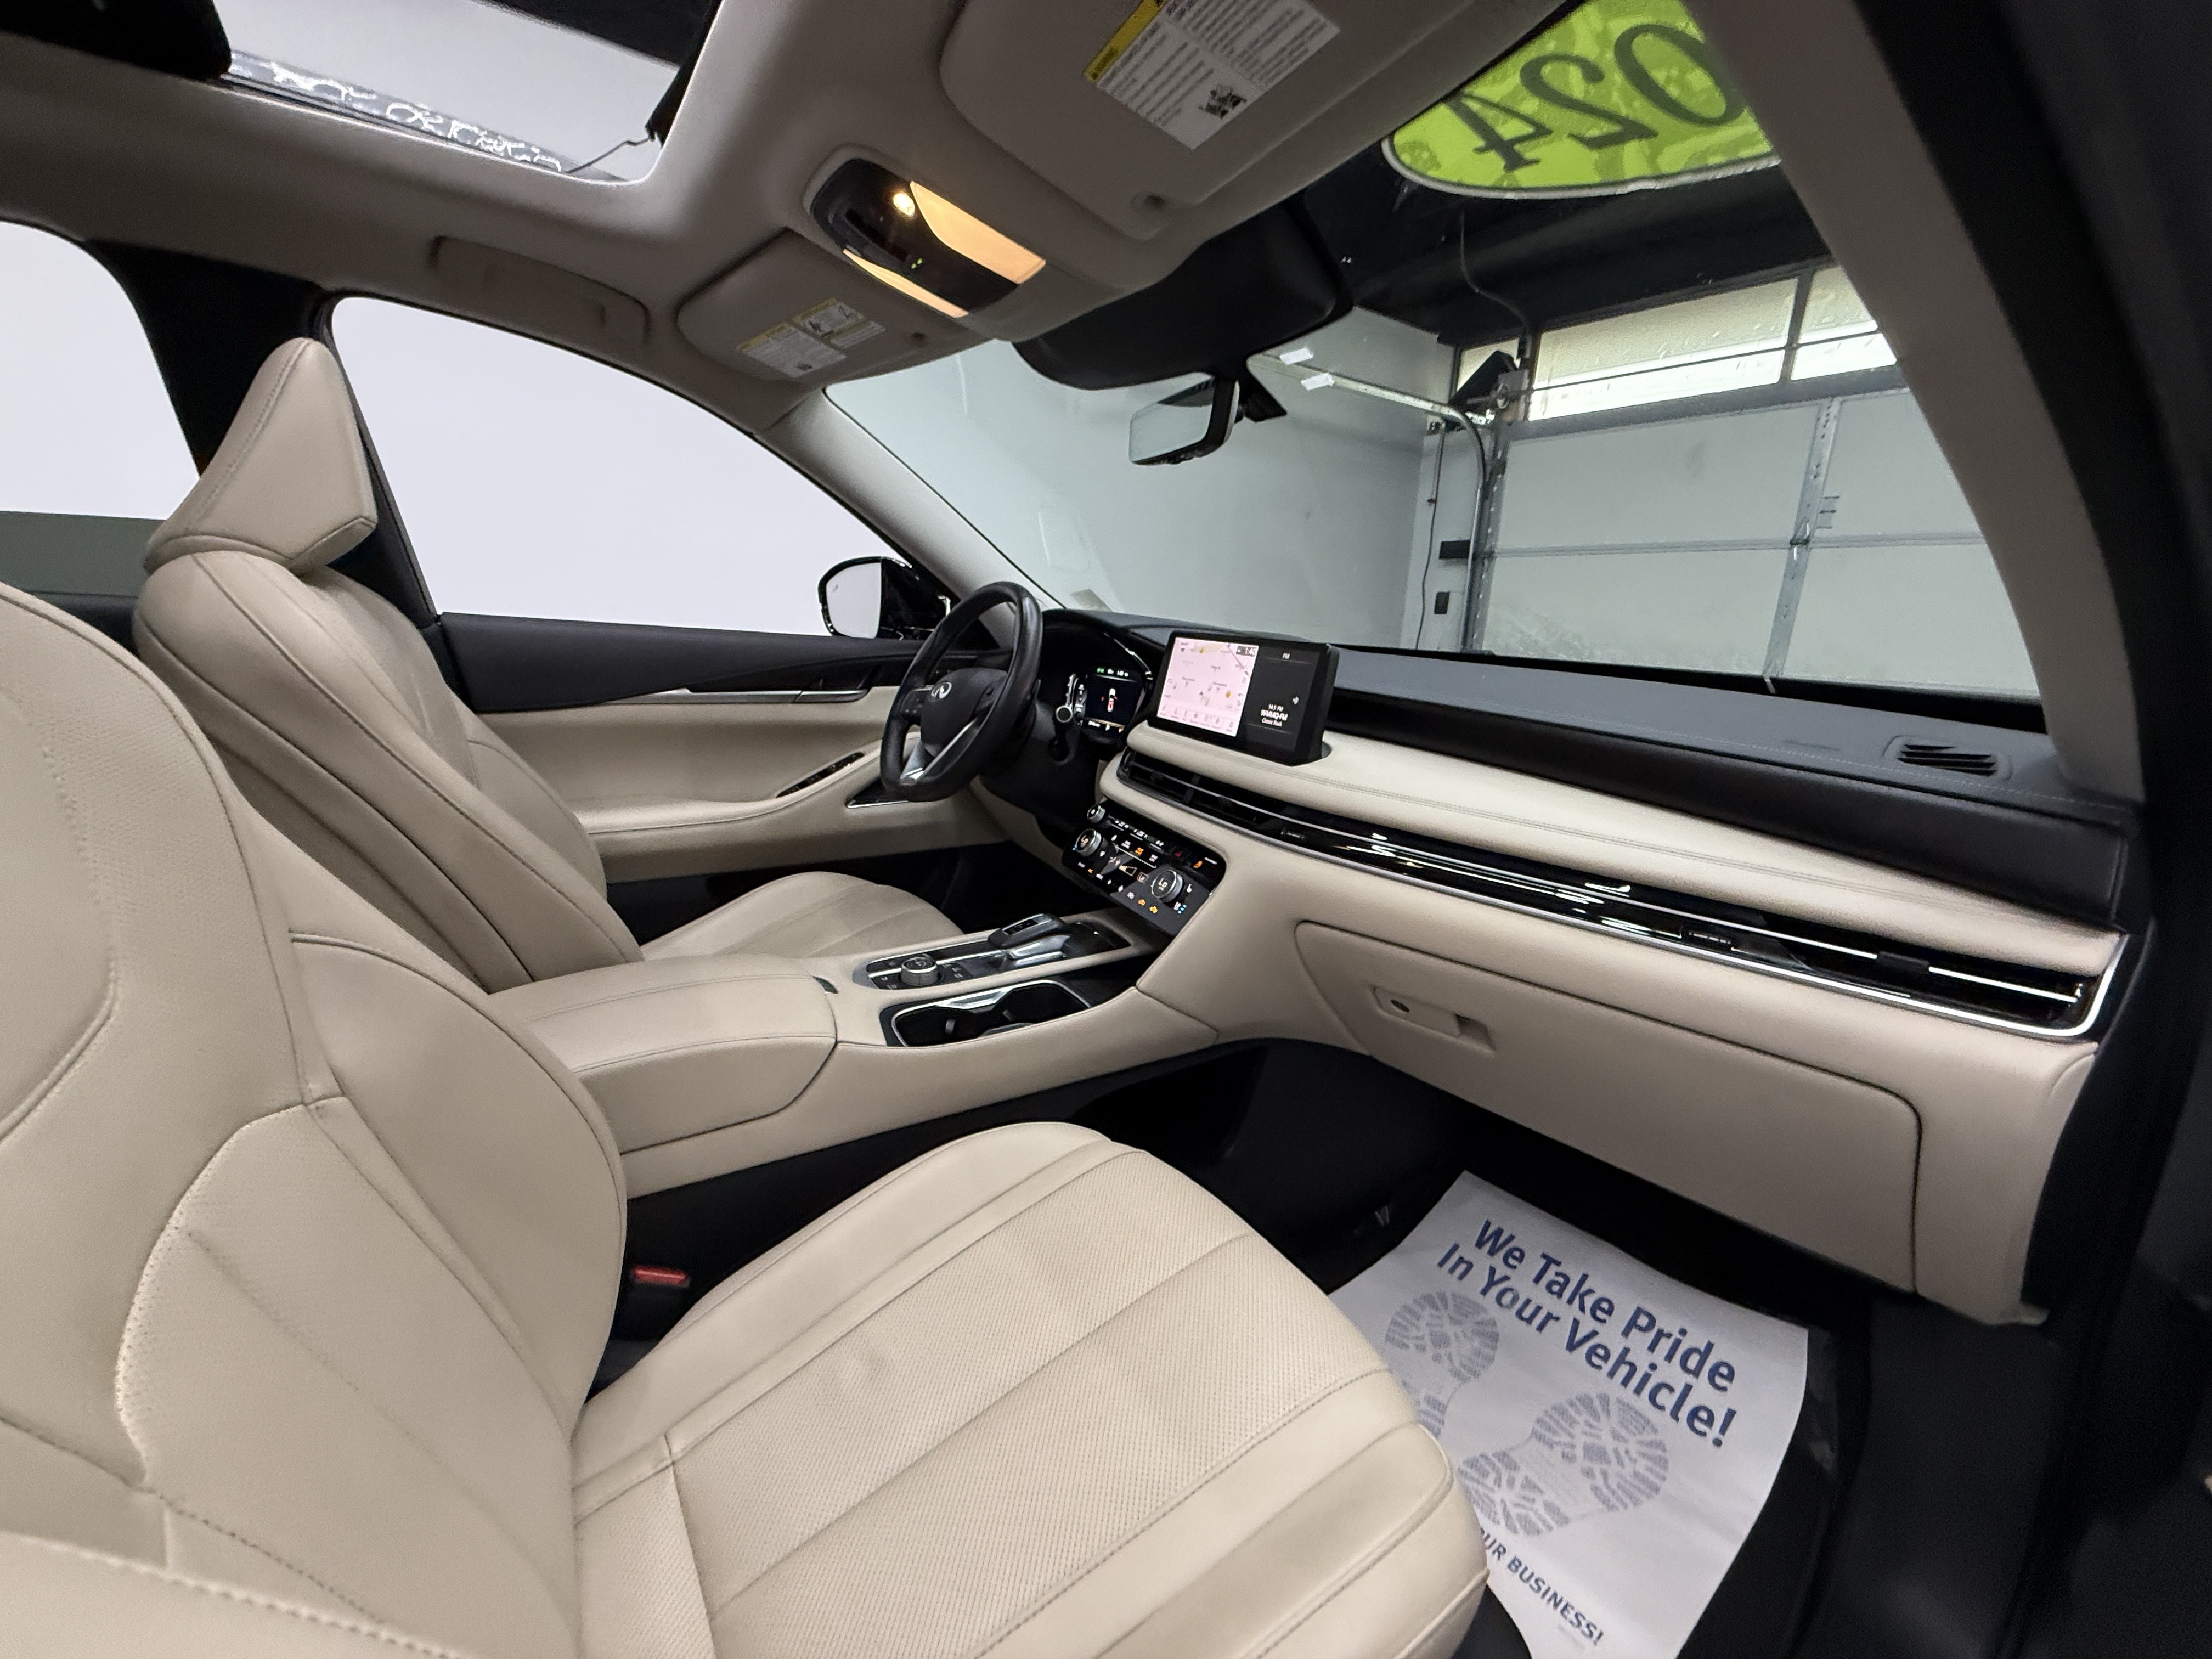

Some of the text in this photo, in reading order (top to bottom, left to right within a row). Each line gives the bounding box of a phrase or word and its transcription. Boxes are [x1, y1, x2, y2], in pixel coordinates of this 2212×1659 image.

[1436, 1242, 1736, 1448] In Your Vehicle!
[1474, 1217, 1736, 1392] We Take Pride
[1507, 1555, 1604, 1646] BUSINESS!
